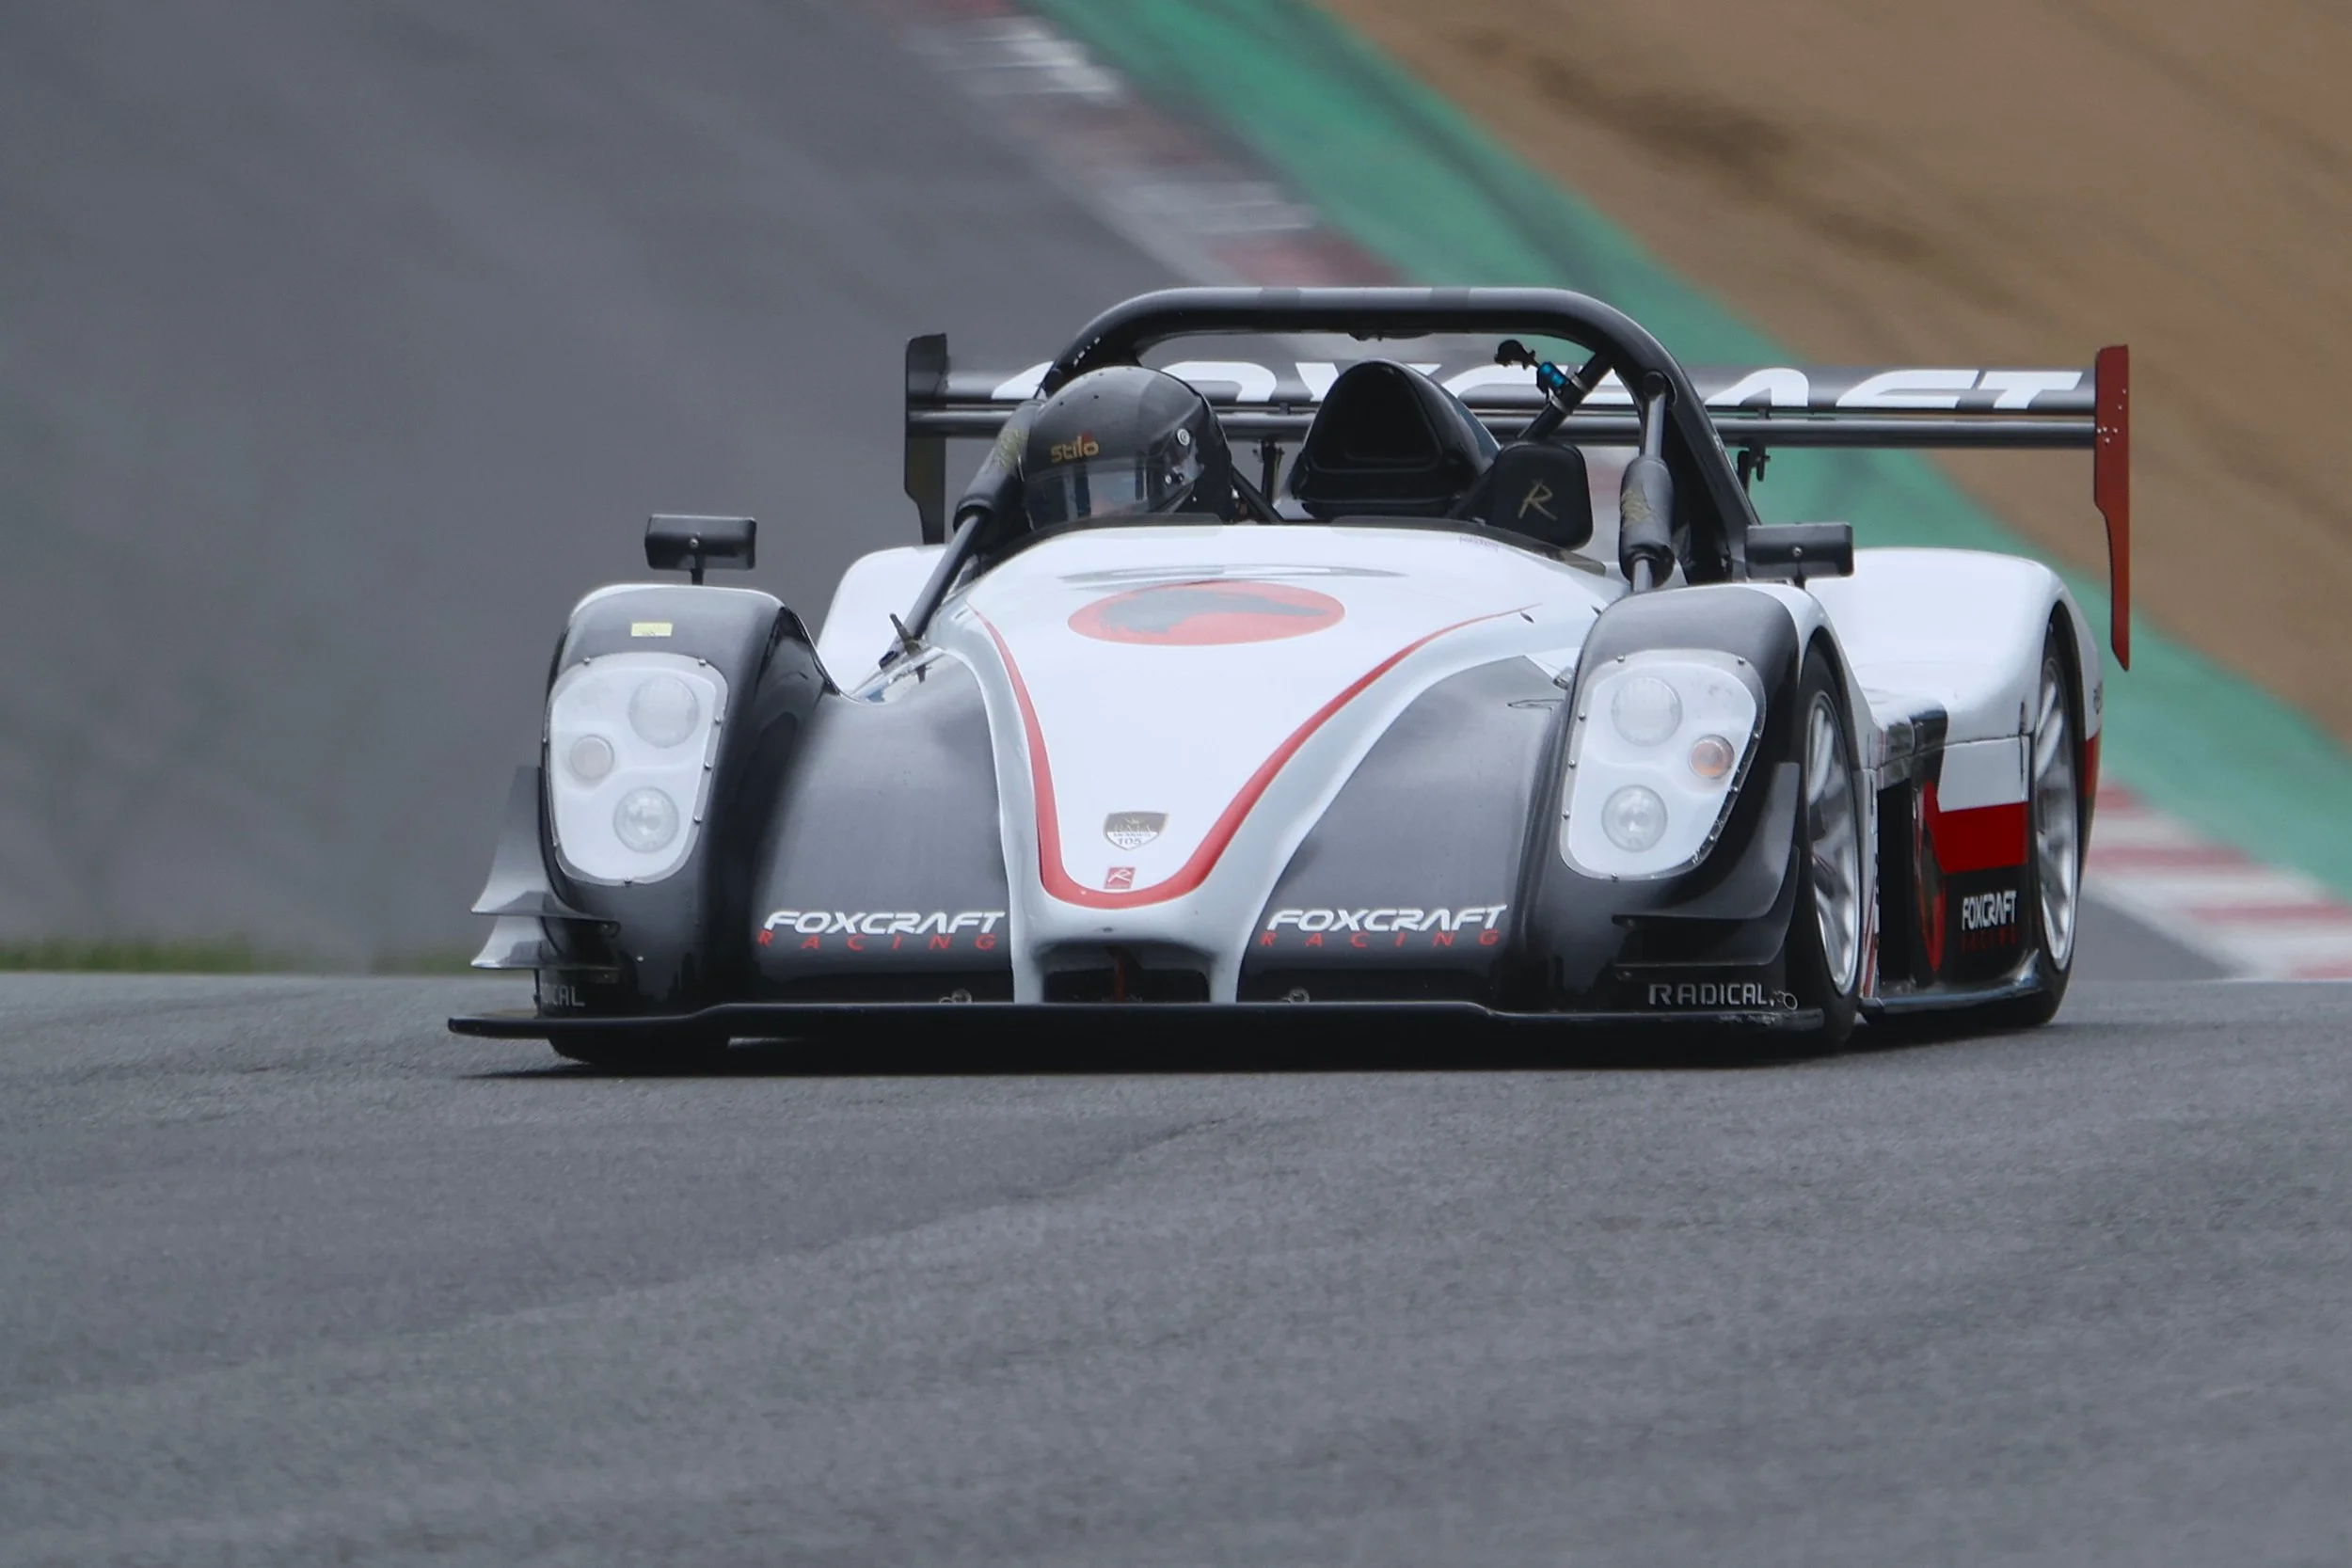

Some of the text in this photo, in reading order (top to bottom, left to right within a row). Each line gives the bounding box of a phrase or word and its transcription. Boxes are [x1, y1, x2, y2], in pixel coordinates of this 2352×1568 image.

[1051, 435, 1100, 464] stilo
[763, 910, 1006, 934] FOXCRAFT
[1266, 904, 1508, 932] FOXCRAFT
[1962, 890, 2017, 931] FOXCRAFT
[757, 928, 996, 952] RACING
[1261, 929, 1500, 948] RACING
